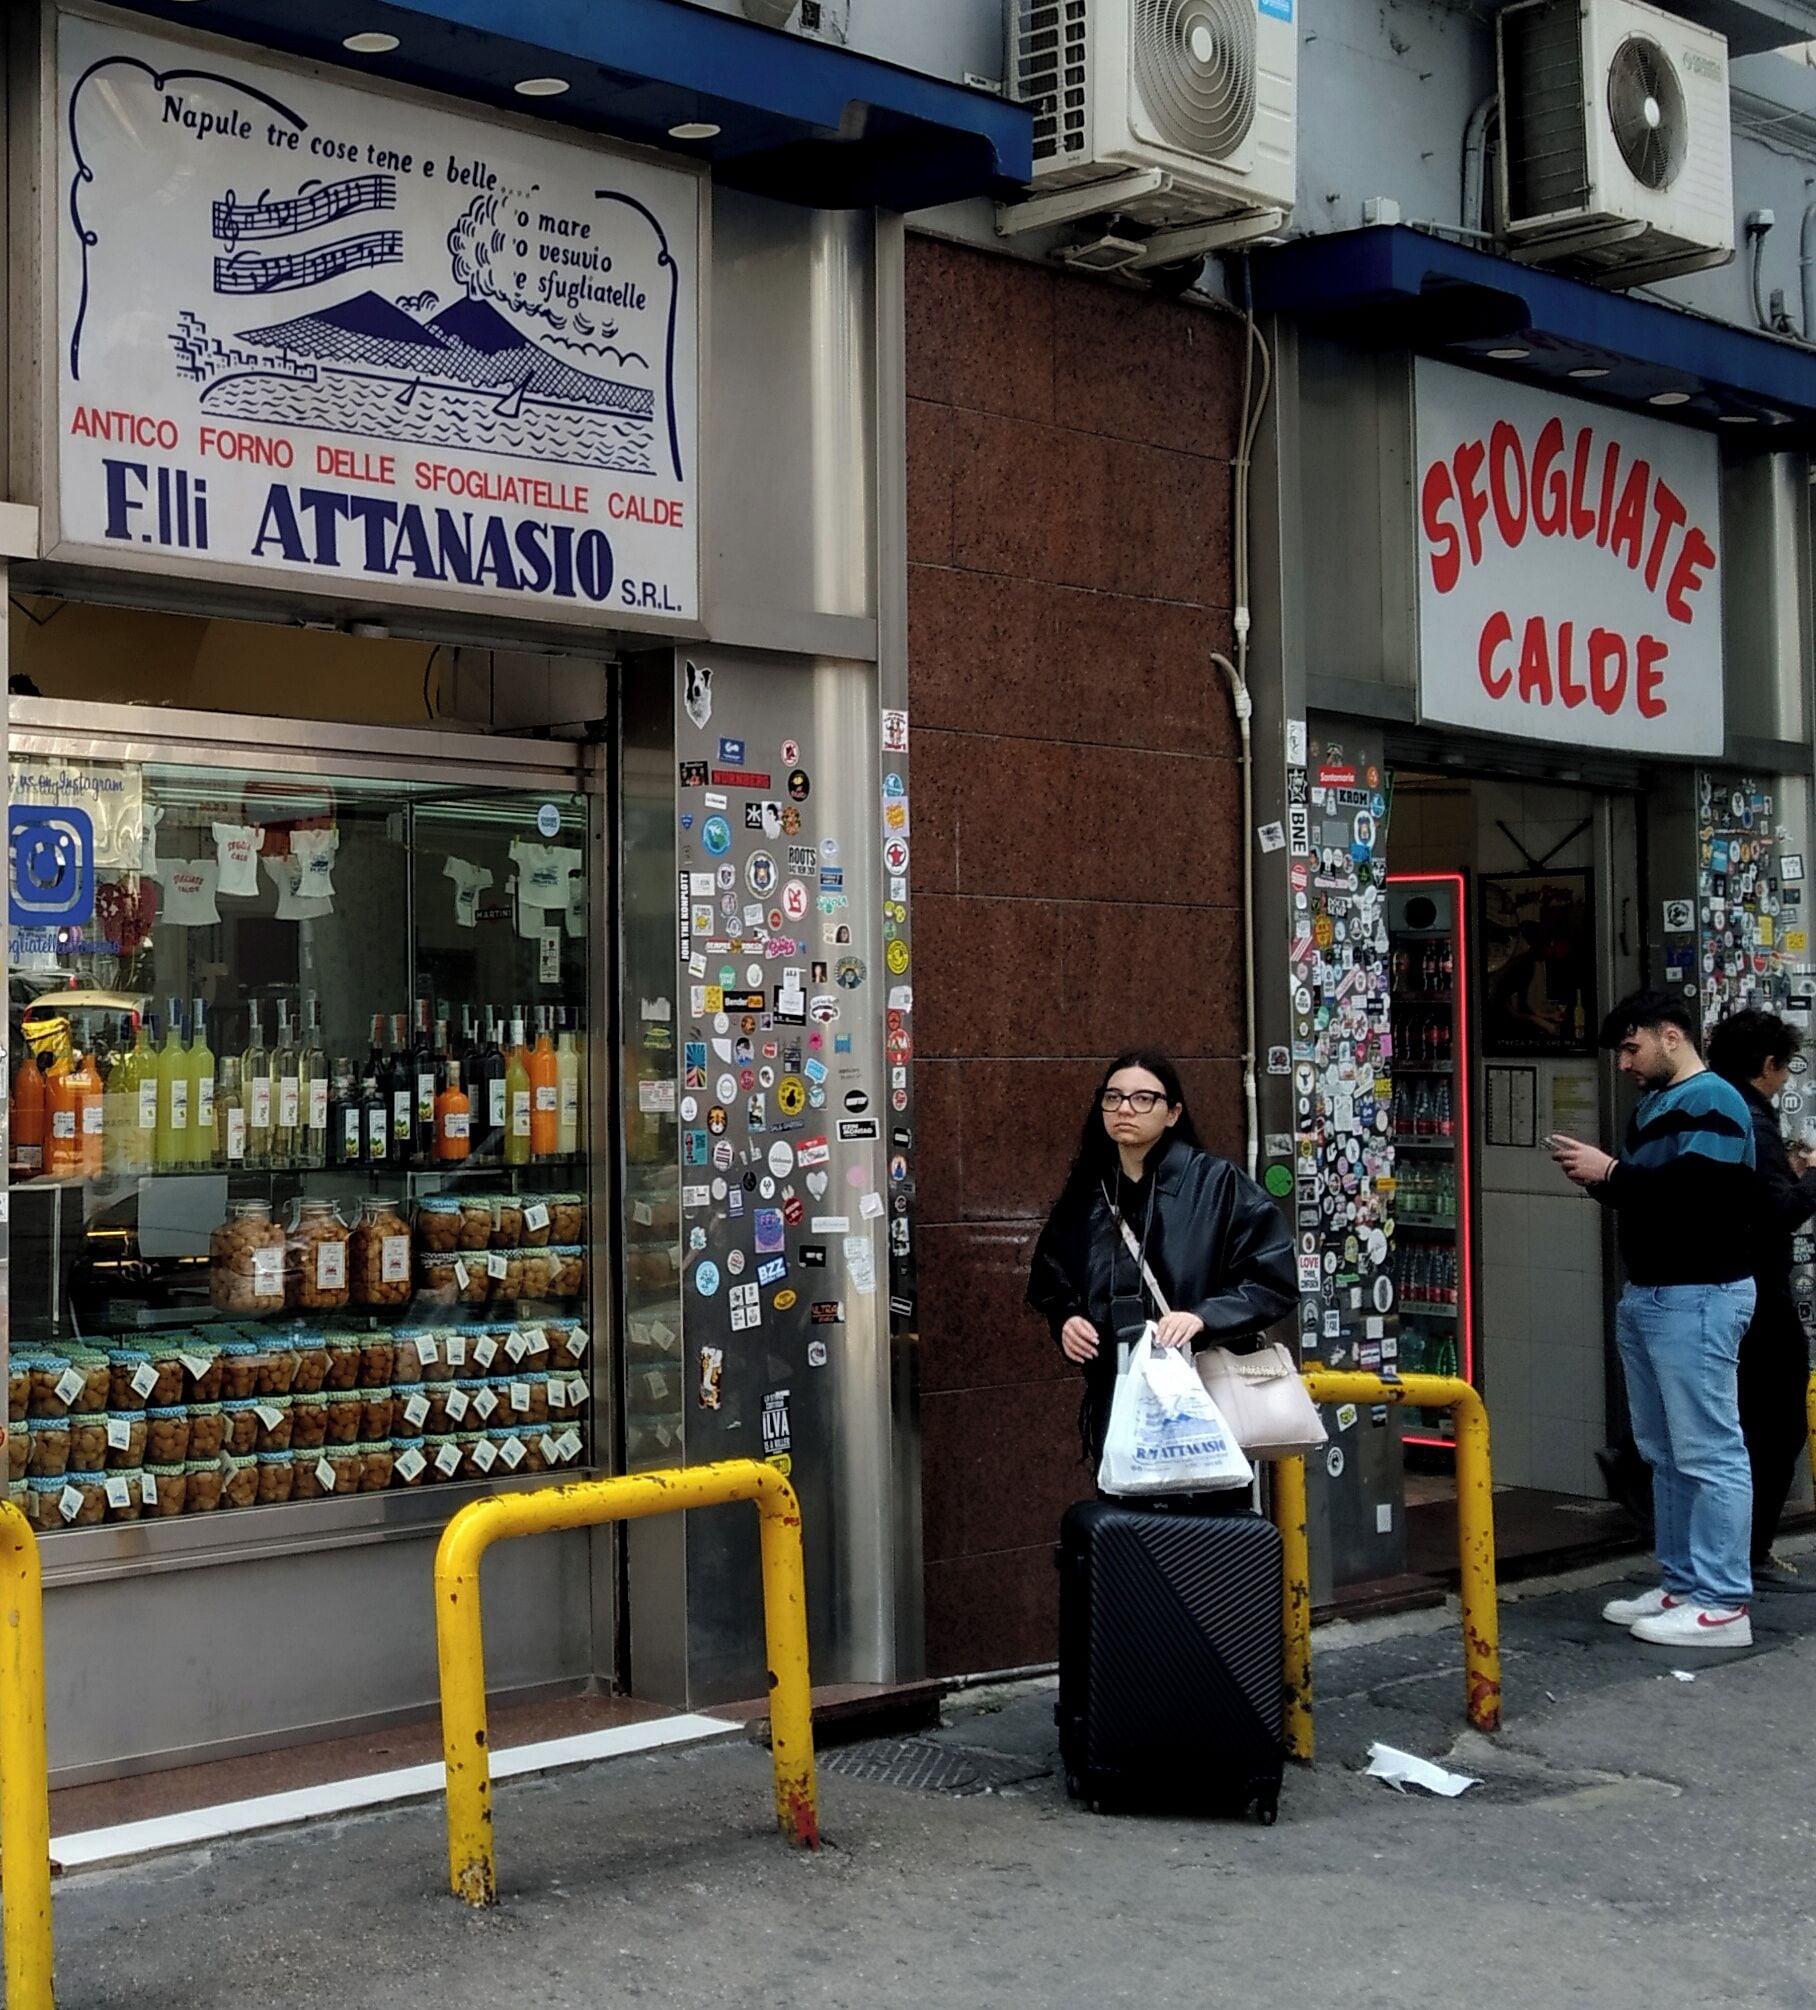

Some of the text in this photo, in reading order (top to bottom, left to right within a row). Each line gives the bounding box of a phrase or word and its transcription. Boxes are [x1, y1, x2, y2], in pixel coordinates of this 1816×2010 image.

[161, 95, 252, 141] Napule
[266, 122, 300, 151] tre
[310, 135, 358, 164] cose
[366, 143, 413, 174] tene
[422, 160, 436, 179] e
[538, 213, 592, 239] mare
[538, 242, 612, 273] vesuvio
[537, 271, 647, 313] sfugliatelle
[70, 405, 685, 529] ANTICO FORNO DELLE SFOGLIATELLE CALDE
[1421, 416, 1717, 626] SFOGLIATE
[250, 482, 615, 602] ATTANASIO
[620, 577, 684, 613] S.R.L.
[1477, 609, 1670, 720] CALDE
[1291, 811, 1306, 854] BNE
[788, 846, 816, 866] ROOTS
[757, 1257, 785, 1279] BZZ
[1300, 1257, 1319, 1269] LOVE
[762, 1410, 790, 1440] ILVA
